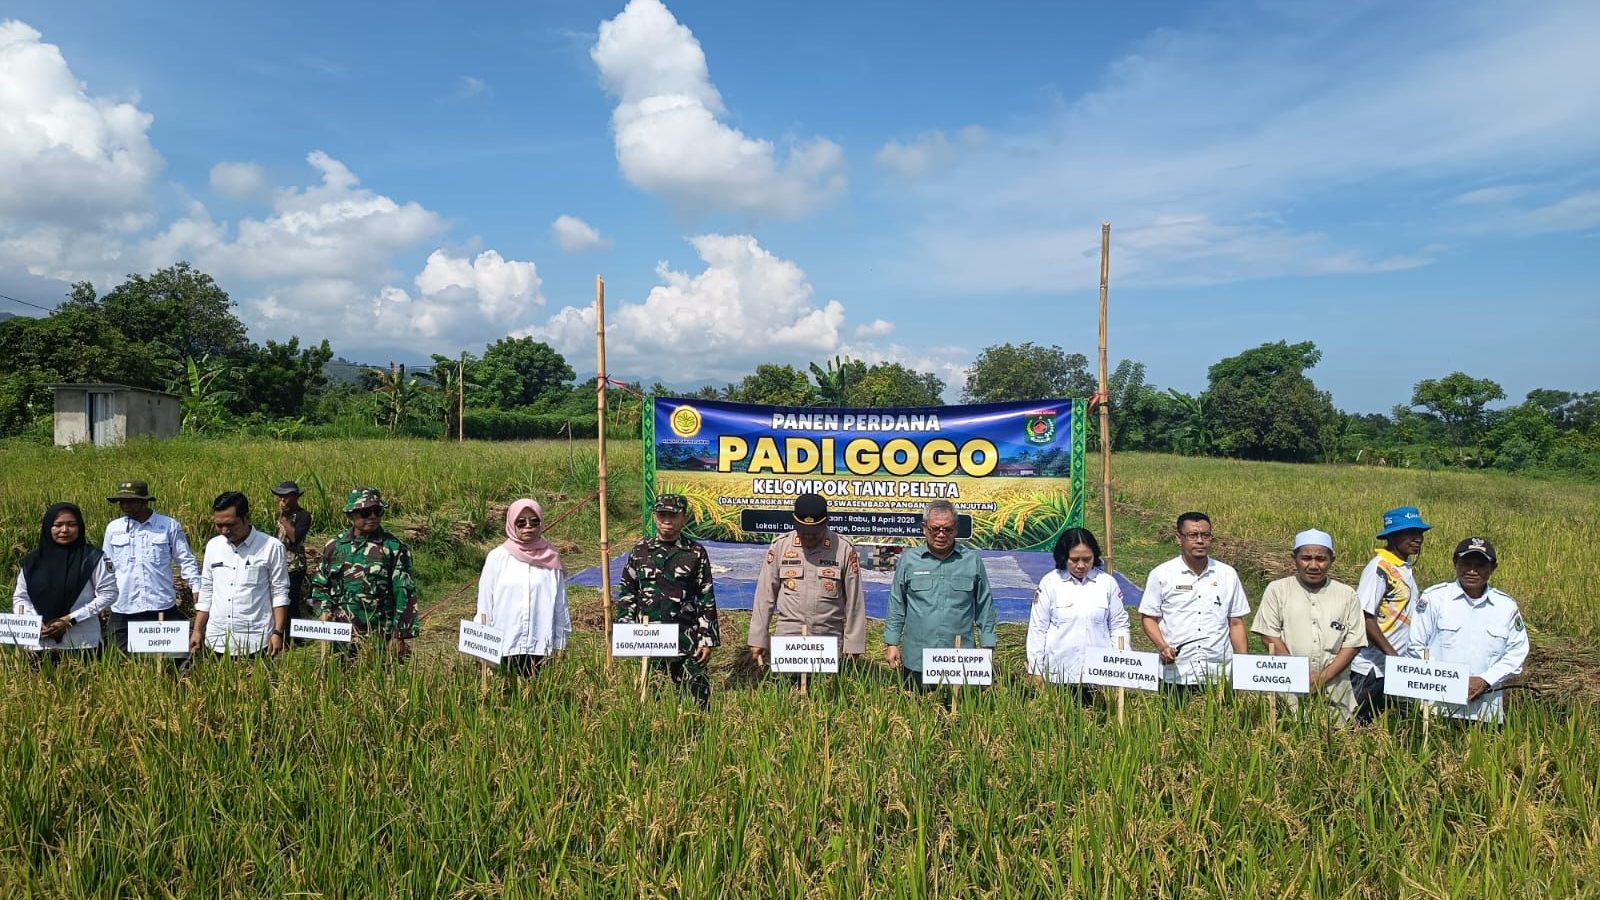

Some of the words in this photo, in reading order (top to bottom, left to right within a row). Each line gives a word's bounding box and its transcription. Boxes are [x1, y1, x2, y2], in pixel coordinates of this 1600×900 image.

[772, 413, 838, 431] PANEN
[843, 414, 941, 432] PERDANA
[718, 436, 836, 475] PADI
[843, 438, 998, 477] GOGO
[753, 479, 850, 496] KELOMPOK
[852, 480, 897, 496] TANI
[899, 481, 960, 498] PELITA
[718, 496, 749, 505] (DALAM
[749, 498, 782, 506] RANGKA
[848, 515, 870, 523] Rabu,
[877, 516, 896, 524] April
[755, 522, 779, 530] Lokasi
[851, 525, 871, 533] Desa
[872, 526, 905, 534] Rempek,
[293, 624, 332, 635] DANRAMIL
[333, 628, 351, 636] 1606
[463, 627, 483, 638] KEPALA
[633, 629, 660, 637] KODIM
[21, 632, 39, 640] UTARA
[148, 639, 172, 647] DKPPP
[464, 640, 488, 653] PROVINSI
[616, 642, 677, 650] 1606/MATARAM
[785, 643, 825, 651] KAPOLRES
[774, 657, 809, 665] LOMBOK
[810, 657, 836, 665] UTARA
[932, 655, 956, 663] KADIS
[957, 656, 984, 664] DKPPP
[1103, 655, 1142, 667] BAPPEDA
[1256, 661, 1288, 670] CAMAT
[926, 669, 961, 677] LOMBOK
[1088, 667, 1126, 679] LOMBOK
[1127, 671, 1156, 682] UTARA
[1396, 664, 1432, 677] KEPALA
[1434, 669, 1460, 680] DESA
[1252, 675, 1292, 684] GANGGA
[1407, 680, 1447, 693] REMPEK
